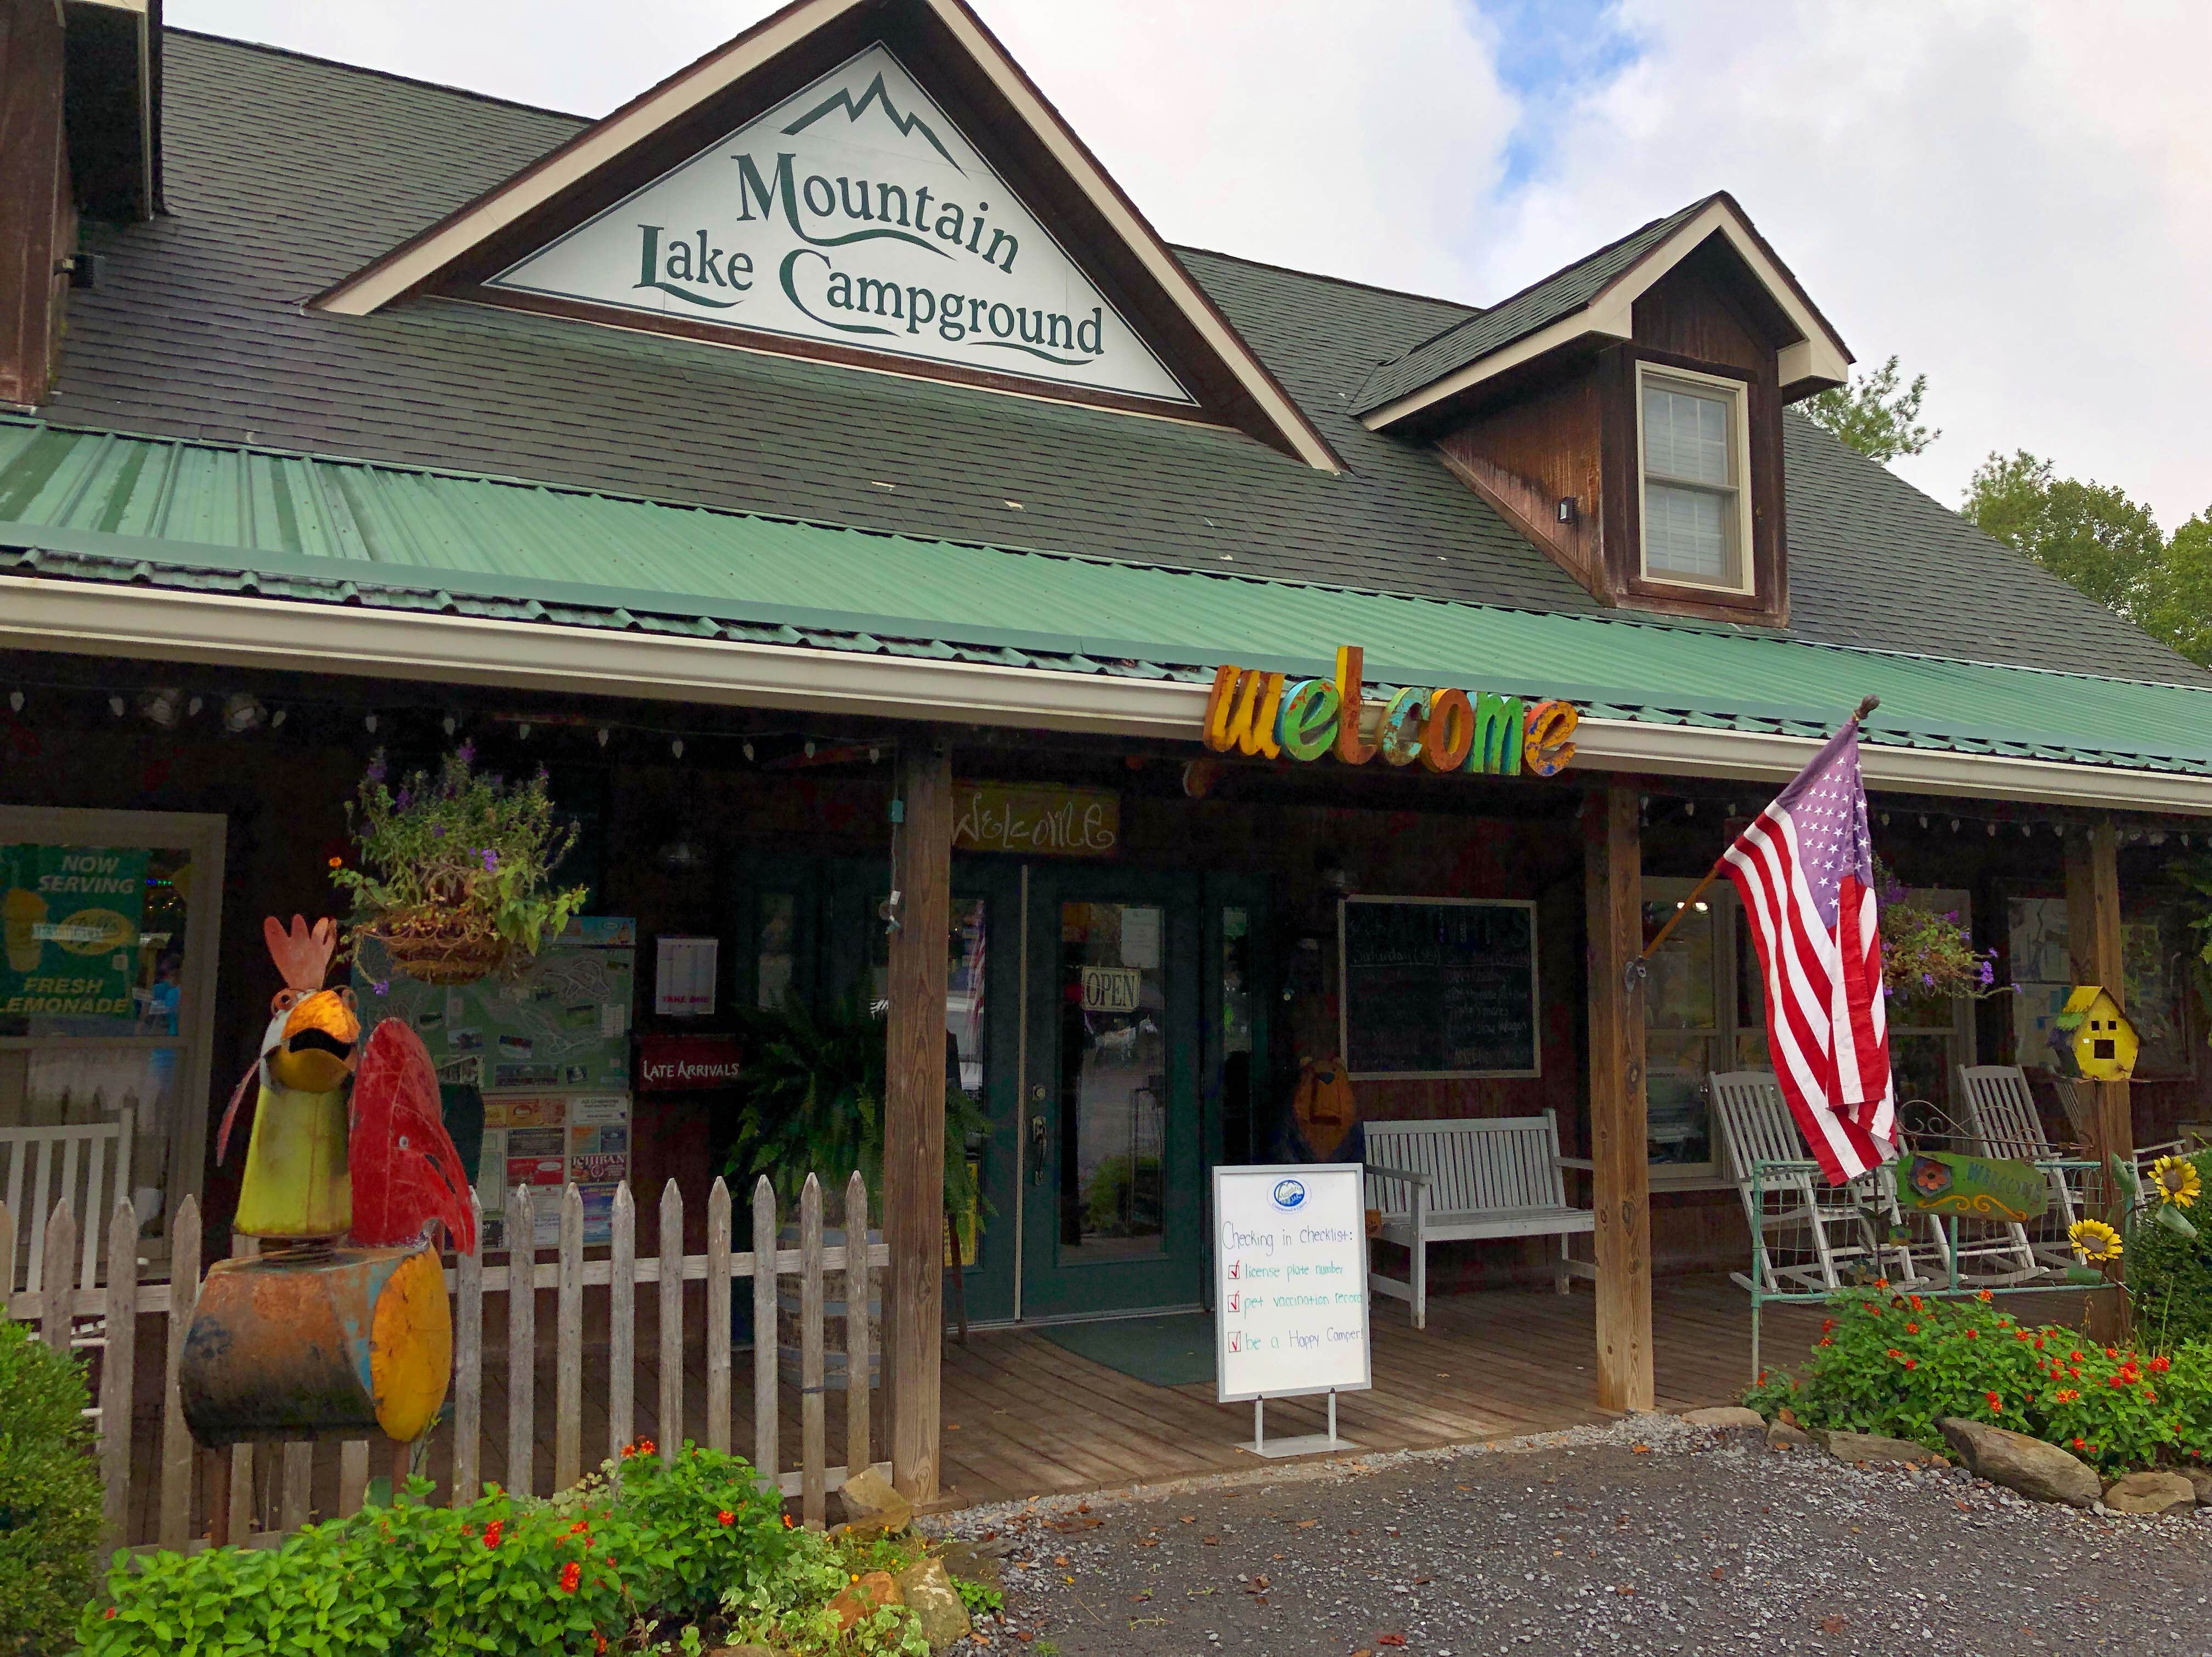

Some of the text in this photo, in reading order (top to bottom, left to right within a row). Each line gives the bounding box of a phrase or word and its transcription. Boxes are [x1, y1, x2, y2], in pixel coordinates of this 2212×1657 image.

[731, 152, 1019, 274] Mountain
[632, 224, 1104, 355] Lake Campground
[1203, 645, 1579, 777] welcome
[61, 855, 120, 874] NOW
[37, 875, 136, 894] SERVING
[23, 977, 104, 994] FRESH
[1085, 972, 1136, 1007] OPEN
[644, 1059, 740, 1083] LATE ARRIVALS
[1222, 1220, 1273, 1257] Checking
[1283, 1229, 1292, 1246] in
[1245, 1261, 1344, 1282] license plate number
[1244, 1297, 1264, 1319] pet
[1273, 1293, 1330, 1307] vaccination
[1245, 1326, 1363, 1350] be a Happy Camper!
